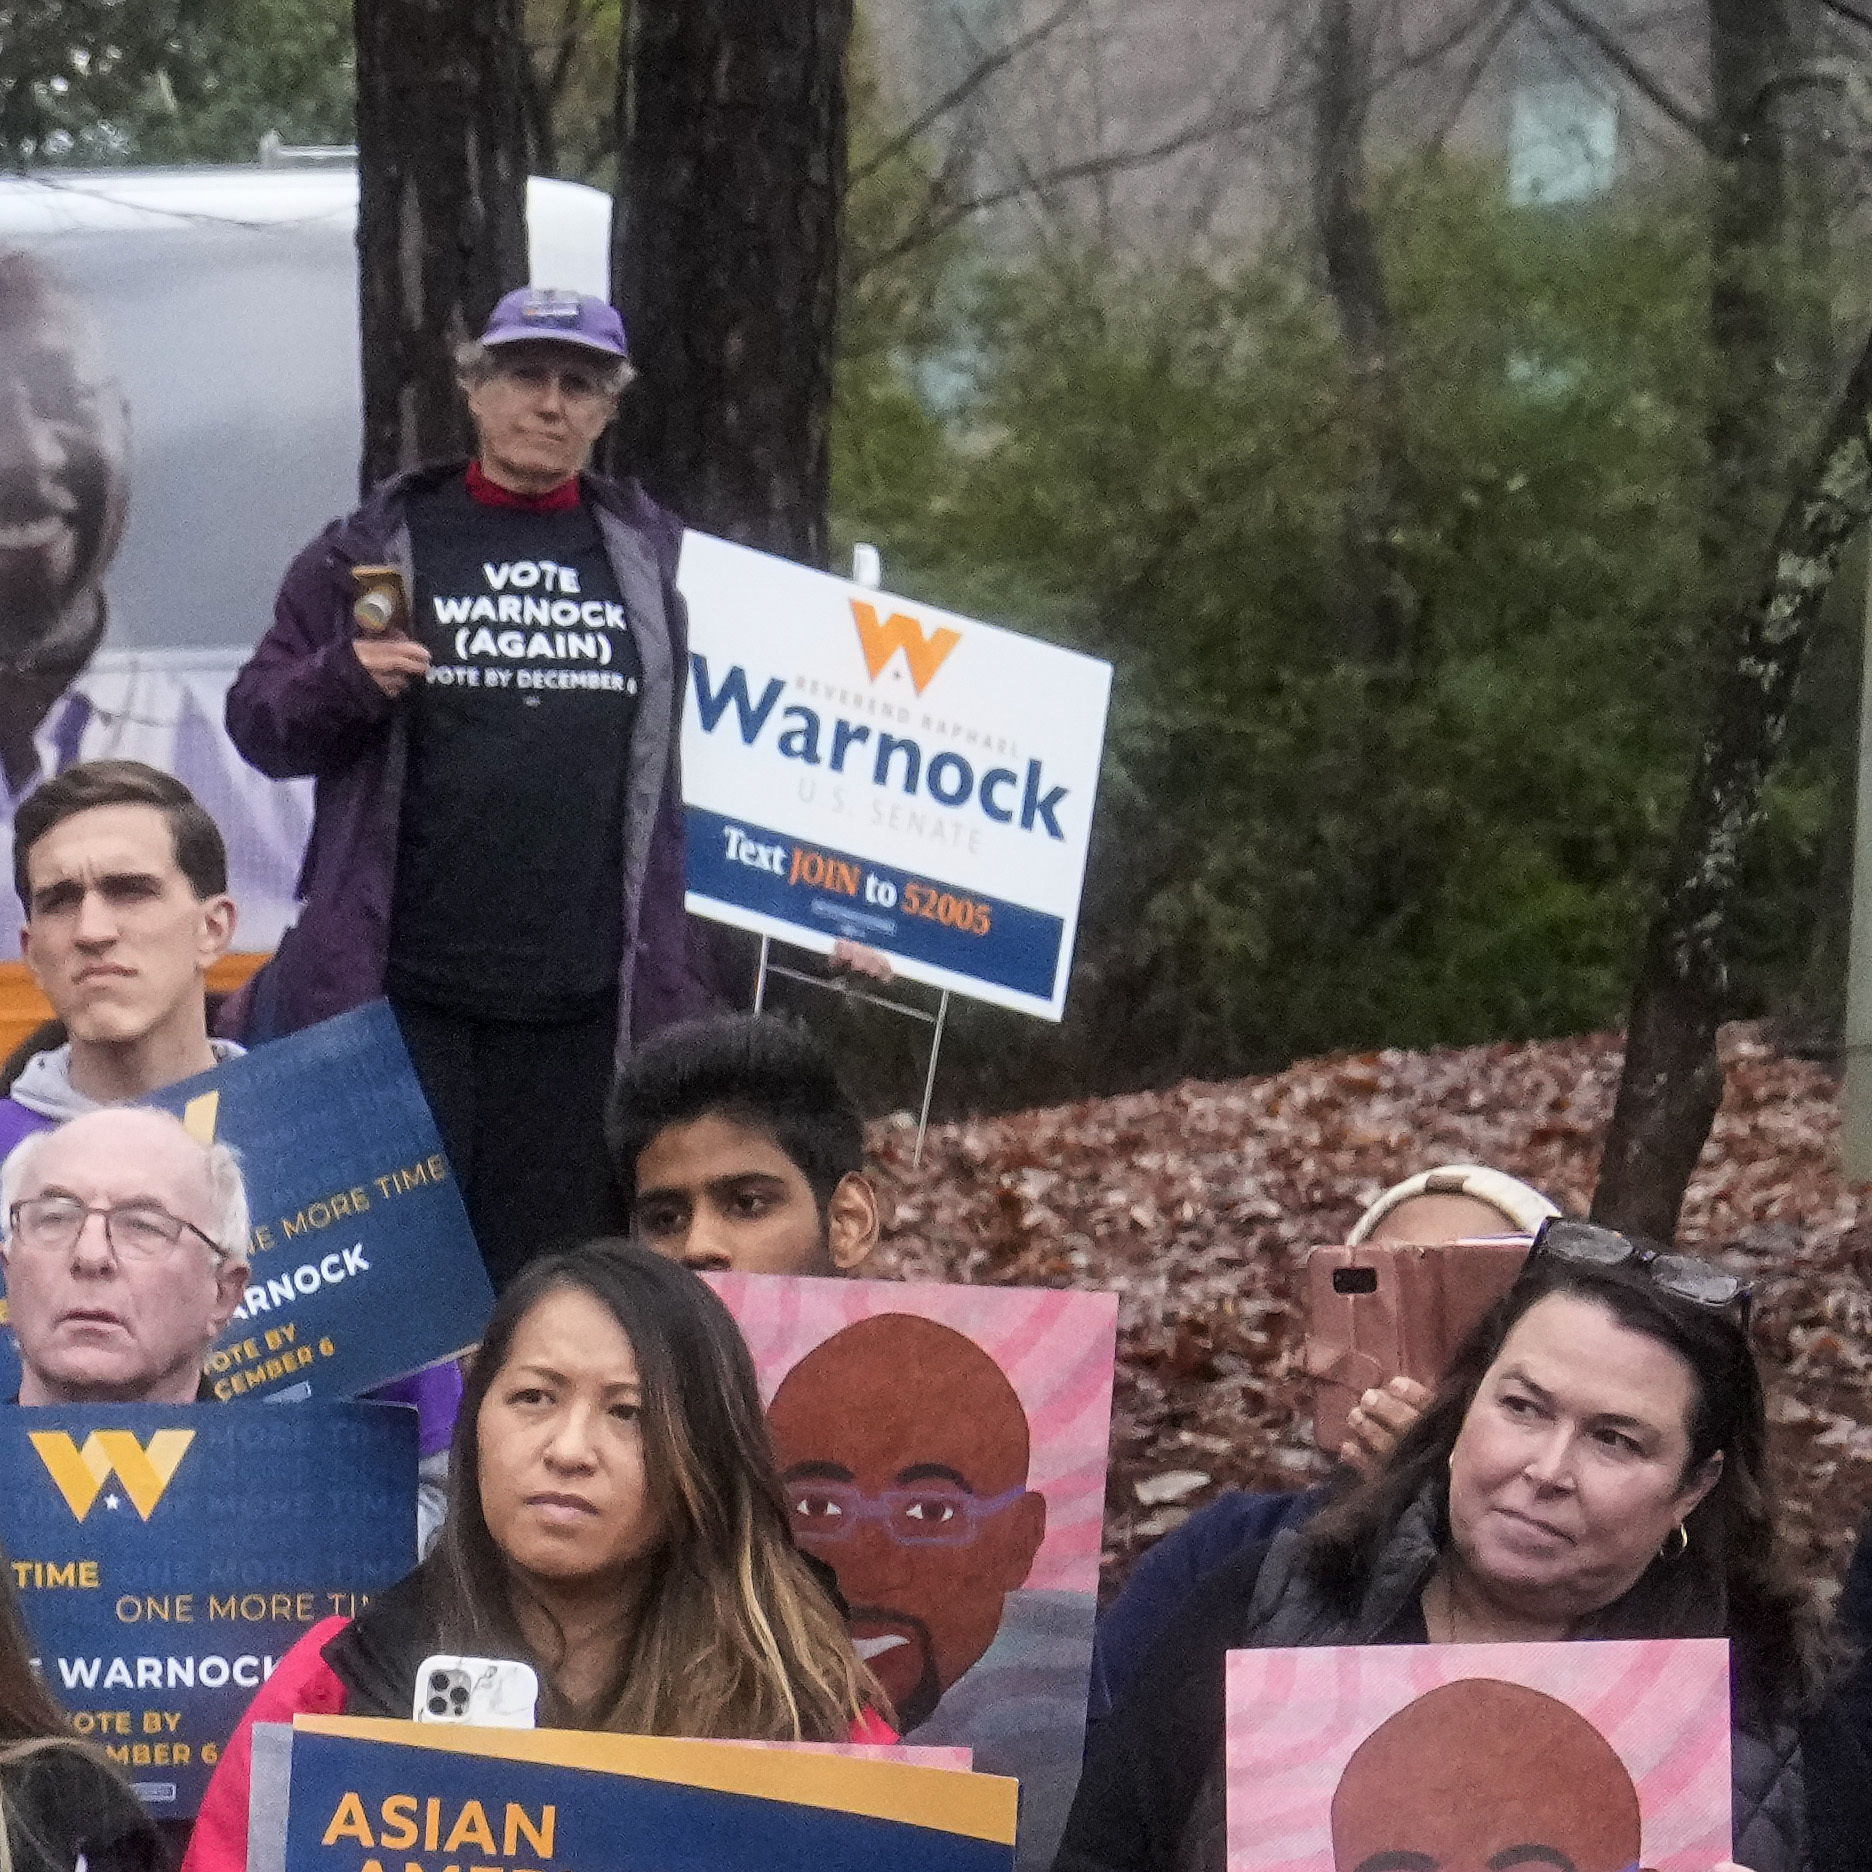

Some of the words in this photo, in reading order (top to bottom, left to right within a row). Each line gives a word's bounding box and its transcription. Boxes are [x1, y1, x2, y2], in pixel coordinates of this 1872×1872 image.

[483, 560, 581, 593] VOTE
[433, 594, 627, 630] WARNOCK
[455, 626, 612, 666] (AGAIN)
[484, 667, 513, 687] BY
[517, 669, 624, 691] DECEMBER
[794, 673, 911, 725] REVEREND
[920, 714, 1022, 759] RAPHAEL
[690, 650, 1071, 843] Warnock
[796, 774, 855, 817] U.S.
[870, 797, 983, 856] SENATE
[722, 823, 787, 877] Text
[789, 845, 861, 896] JOIN
[864, 871, 898, 909] to
[900, 881, 993, 938] 52005
[282, 1185, 371, 1242] MORE
[378, 1152, 447, 1200] TIME
[233, 1242, 371, 1320] RNOCK
[204, 1339, 262, 1376] OTE
[264, 1323, 296, 1351] BY
[213, 1346, 314, 1402] CEMBER
[319, 1337, 335, 1357] 6
[13, 1560, 100, 1590] TIME
[115, 1595, 194, 1624] ONE
[209, 1593, 315, 1623] MORE
[327, 1593, 370, 1620] TI
[66, 1711, 130, 1735] OTE
[142, 1711, 182, 1735] BY
[106, 1743, 191, 1766] MBER
[201, 1743, 218, 1766] 6
[321, 1790, 557, 1861] ASIAN
